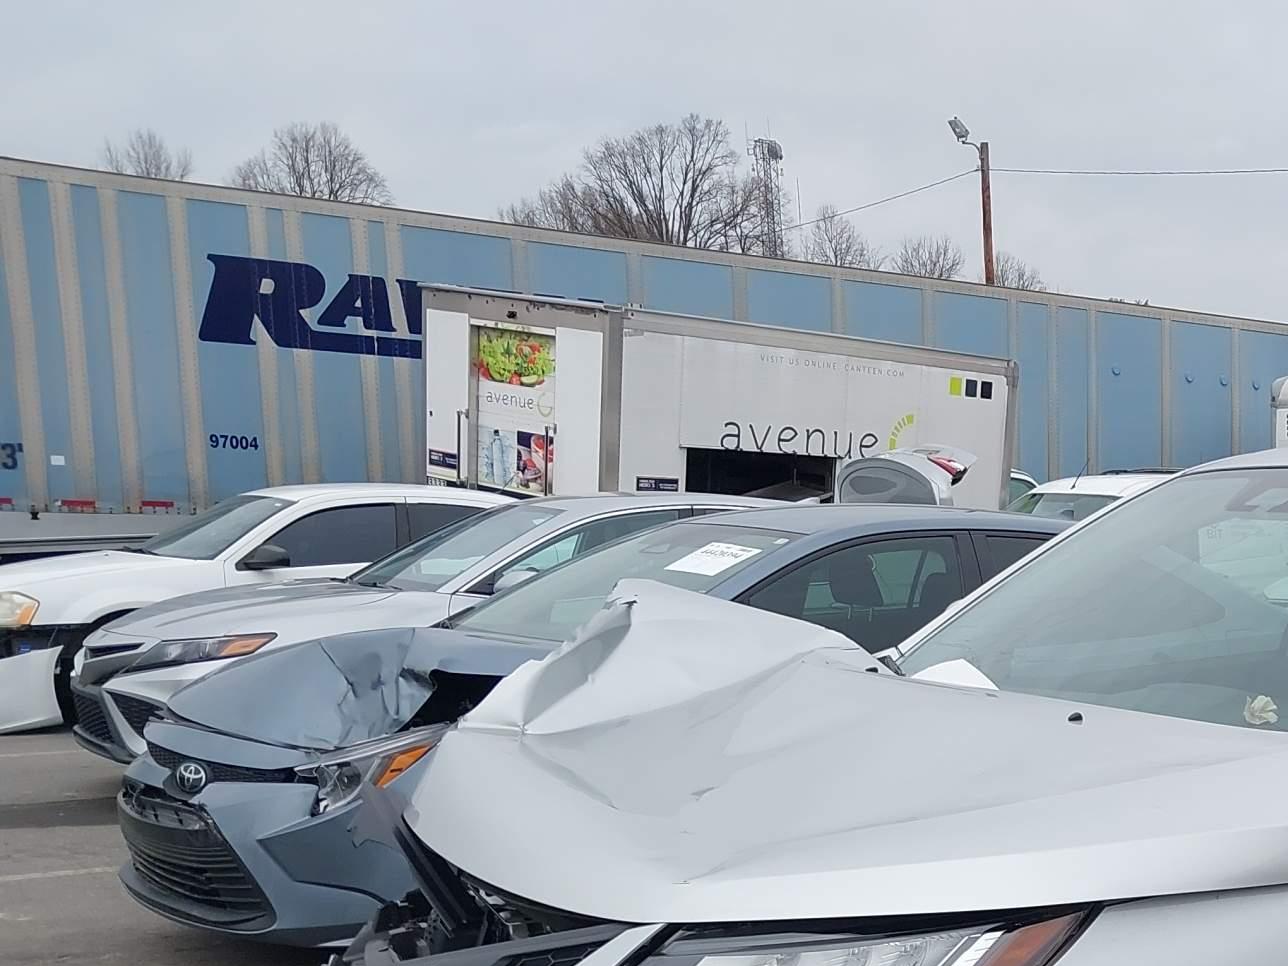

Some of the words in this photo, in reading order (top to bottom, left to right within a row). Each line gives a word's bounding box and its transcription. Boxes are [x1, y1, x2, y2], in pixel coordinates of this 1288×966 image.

[760, 353, 784, 365] VISIT
[789, 357, 801, 367] US
[804, 359, 837, 371] ONLINE
[486, 391, 534, 410] avenue
[209, 433, 259, 451] 97004
[720, 421, 879, 459] avenue
